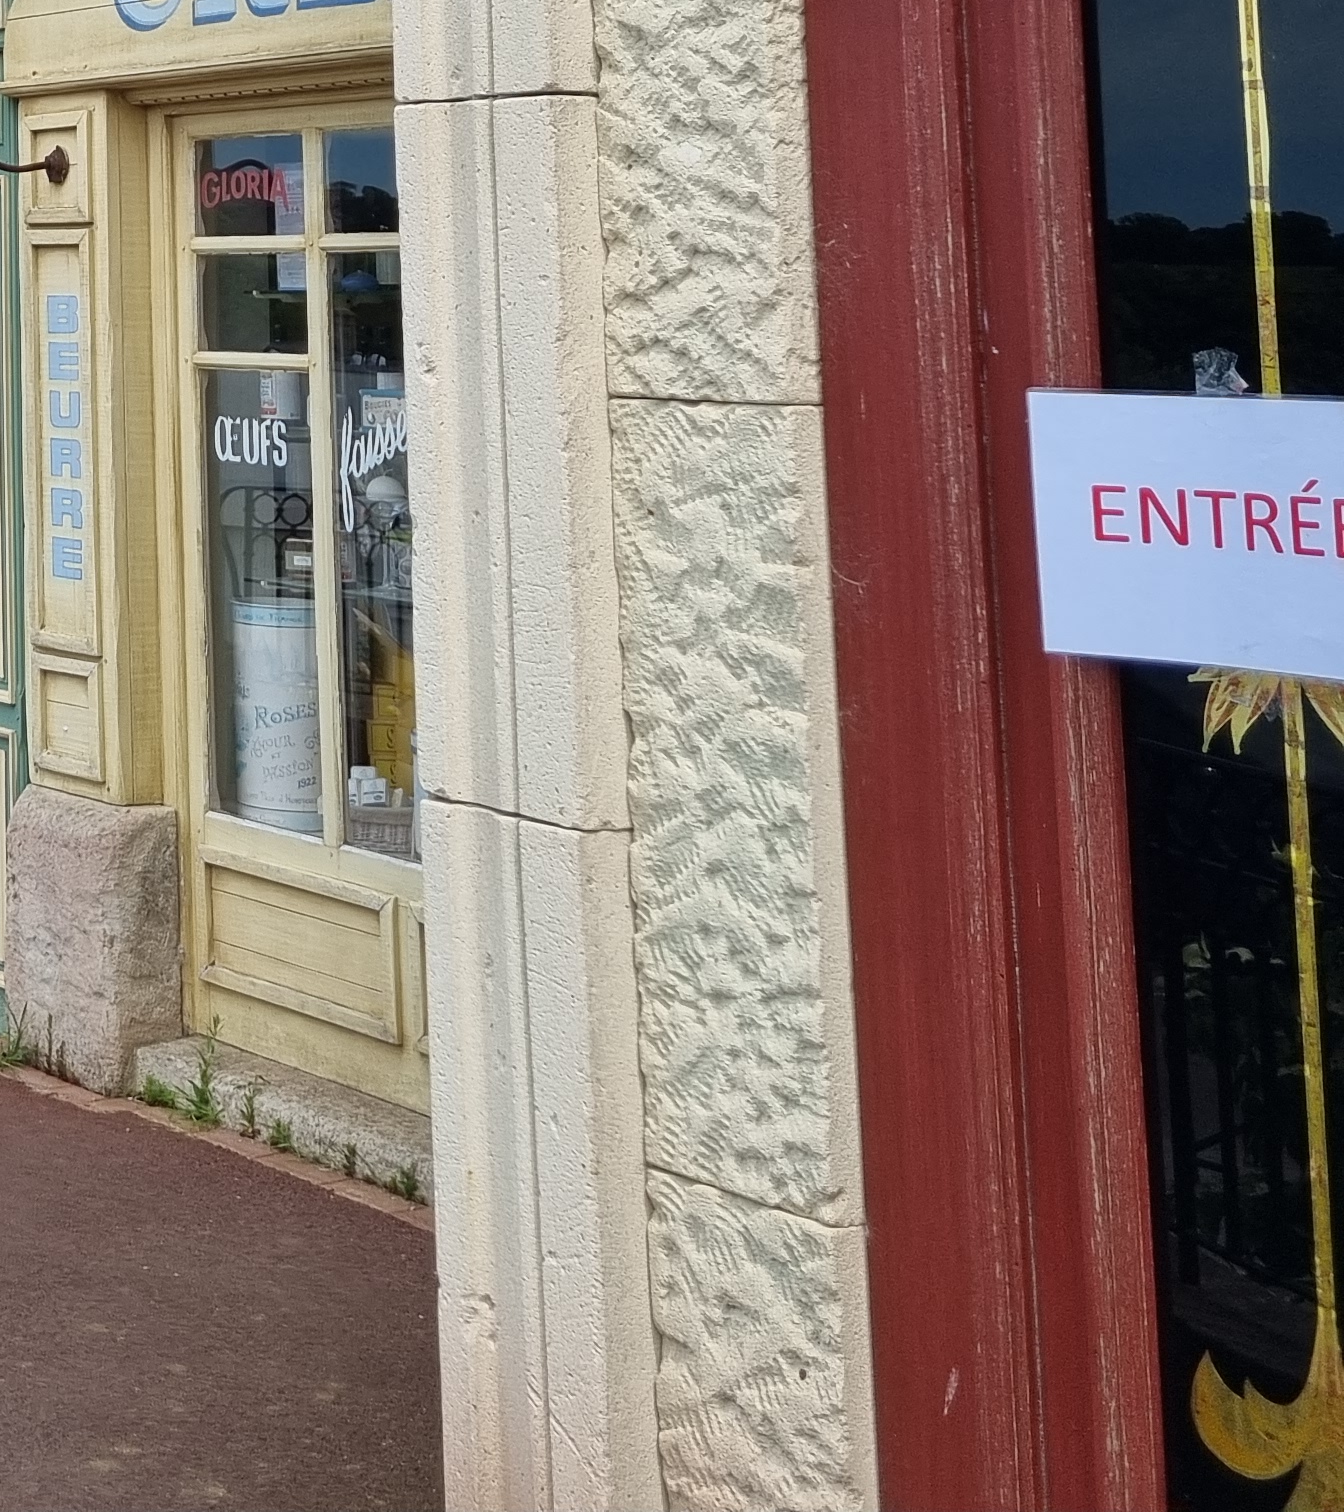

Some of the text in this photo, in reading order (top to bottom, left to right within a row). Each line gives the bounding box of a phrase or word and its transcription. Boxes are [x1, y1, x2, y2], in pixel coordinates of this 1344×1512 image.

[201, 166, 290, 211] GLORIA
[46, 294, 84, 581] BEURRE
[214, 414, 289, 468] ŒUFS
[296, 776, 317, 790] 1922
